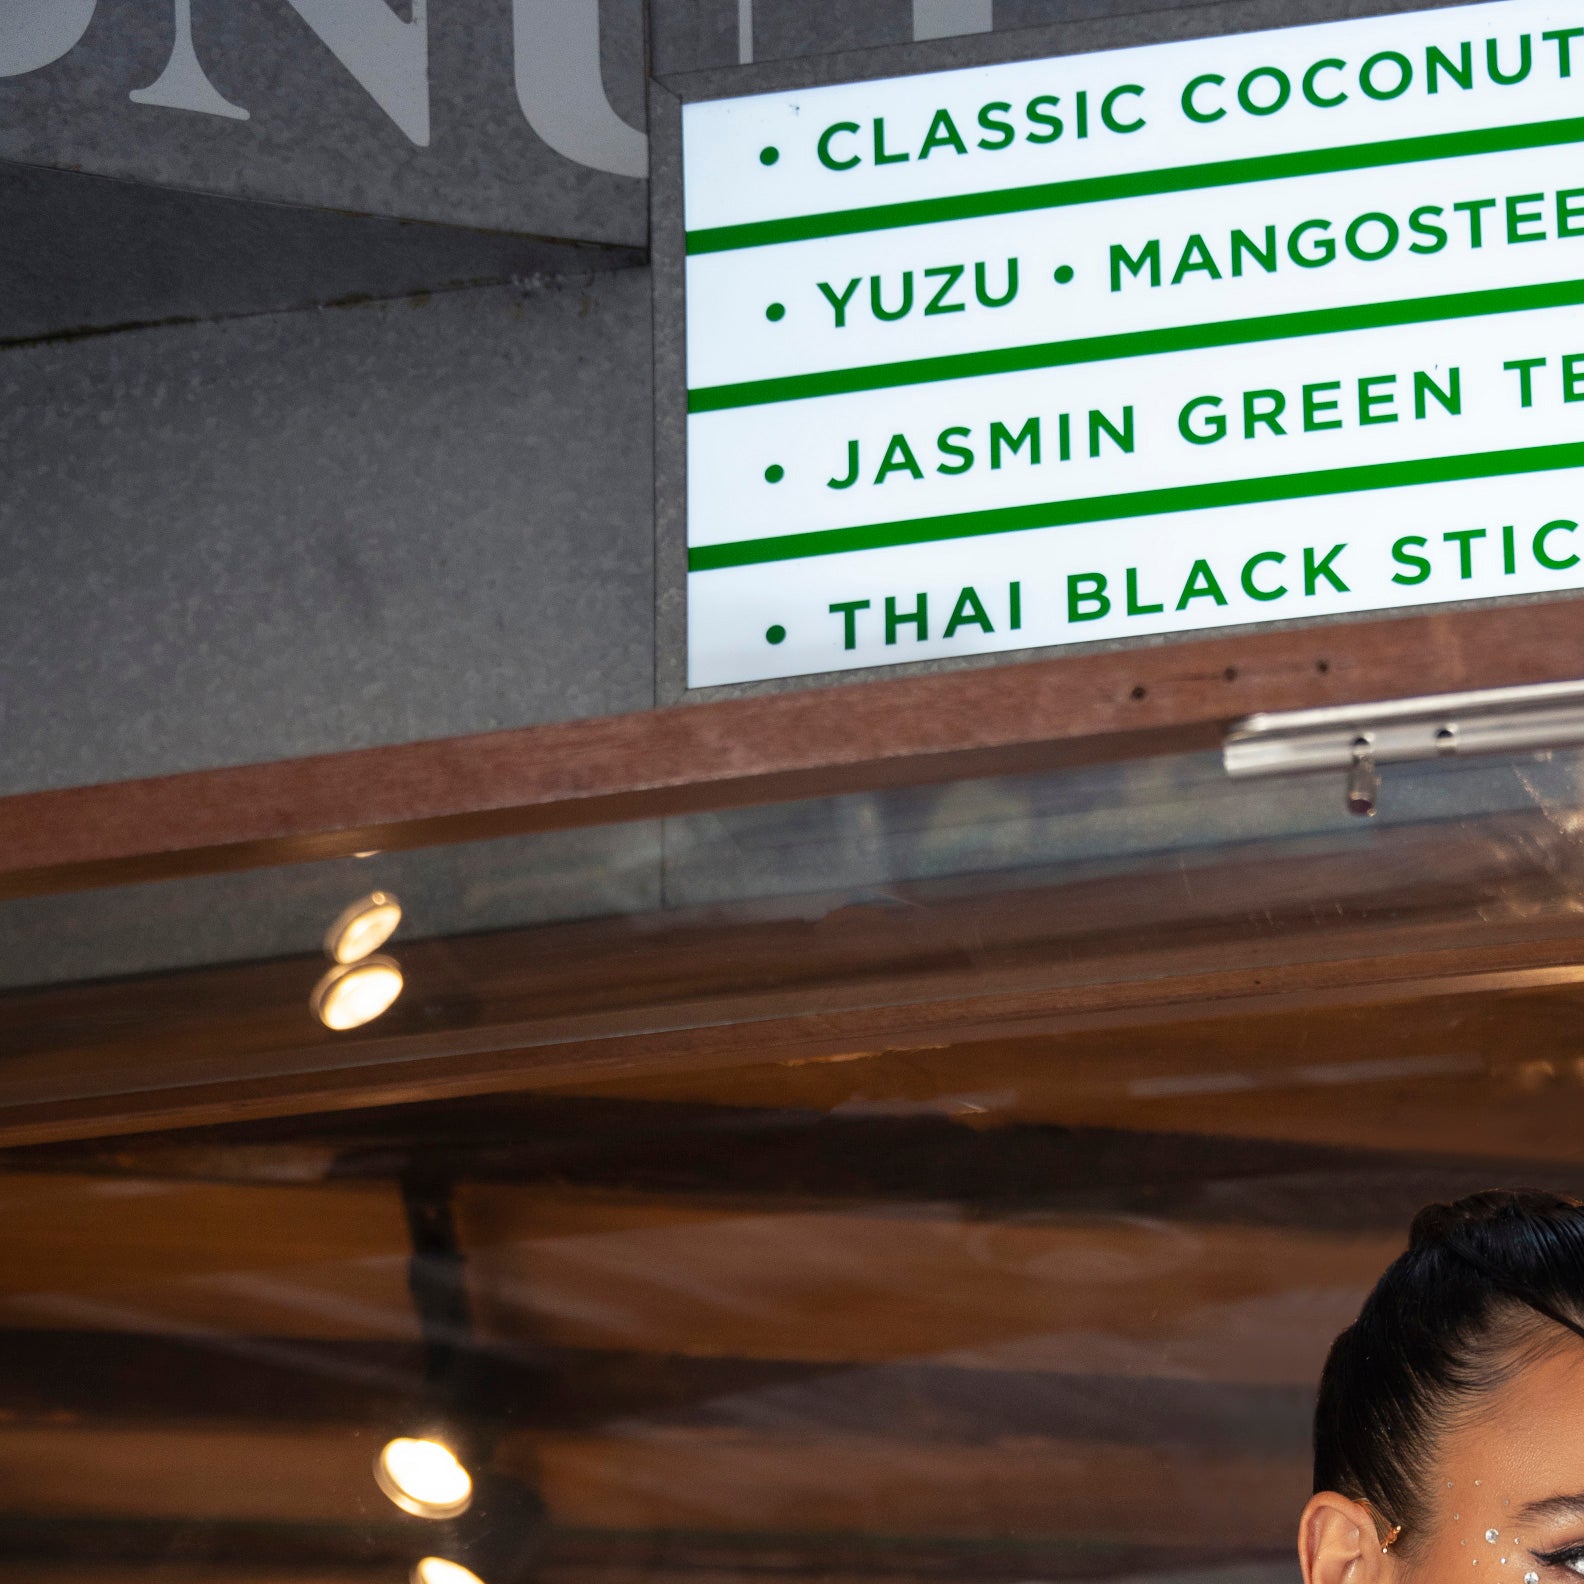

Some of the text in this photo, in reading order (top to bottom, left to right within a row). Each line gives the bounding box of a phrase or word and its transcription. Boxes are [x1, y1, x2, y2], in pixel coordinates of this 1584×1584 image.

[816, 83, 1147, 172] CLASSIC
[817, 256, 1019, 329] YUZU
[827, 404, 1135, 491] JASMIN
[1177, 366, 1462, 446] GREEN
[829, 580, 1022, 649] THAI
[1067, 543, 1350, 624] BLACK
